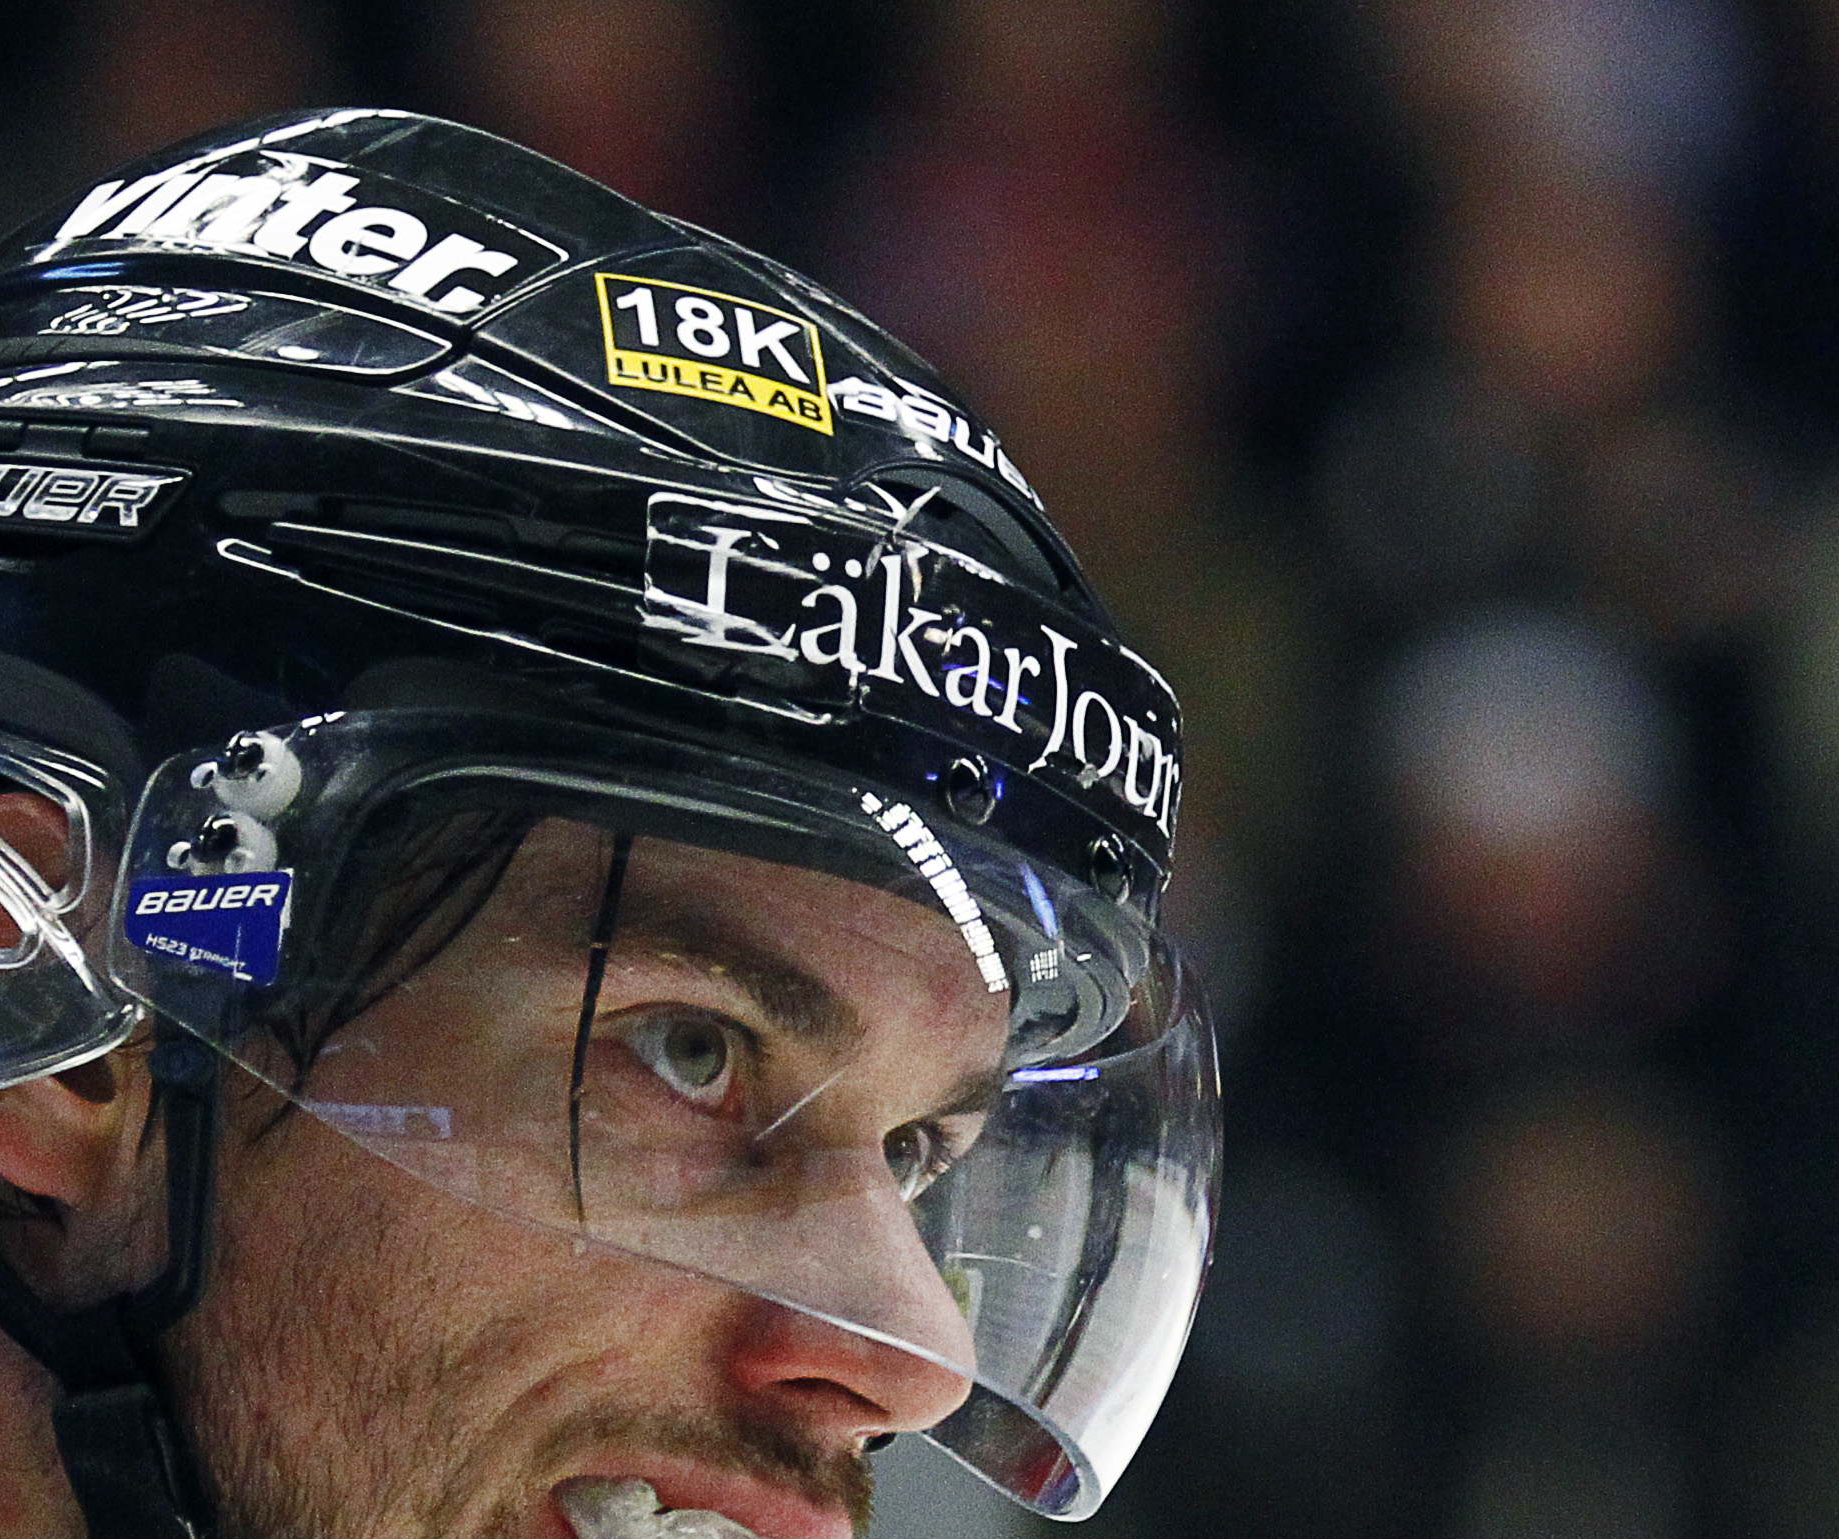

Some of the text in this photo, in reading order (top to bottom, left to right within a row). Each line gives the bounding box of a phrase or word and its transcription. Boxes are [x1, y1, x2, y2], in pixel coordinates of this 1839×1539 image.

[616, 286, 811, 385] 18K
[616, 356, 824, 422] LULEA AB
[843, 380, 1045, 512] BAUE
[135, 883, 281, 915] BAUER
[145, 933, 188, 956] HS23
